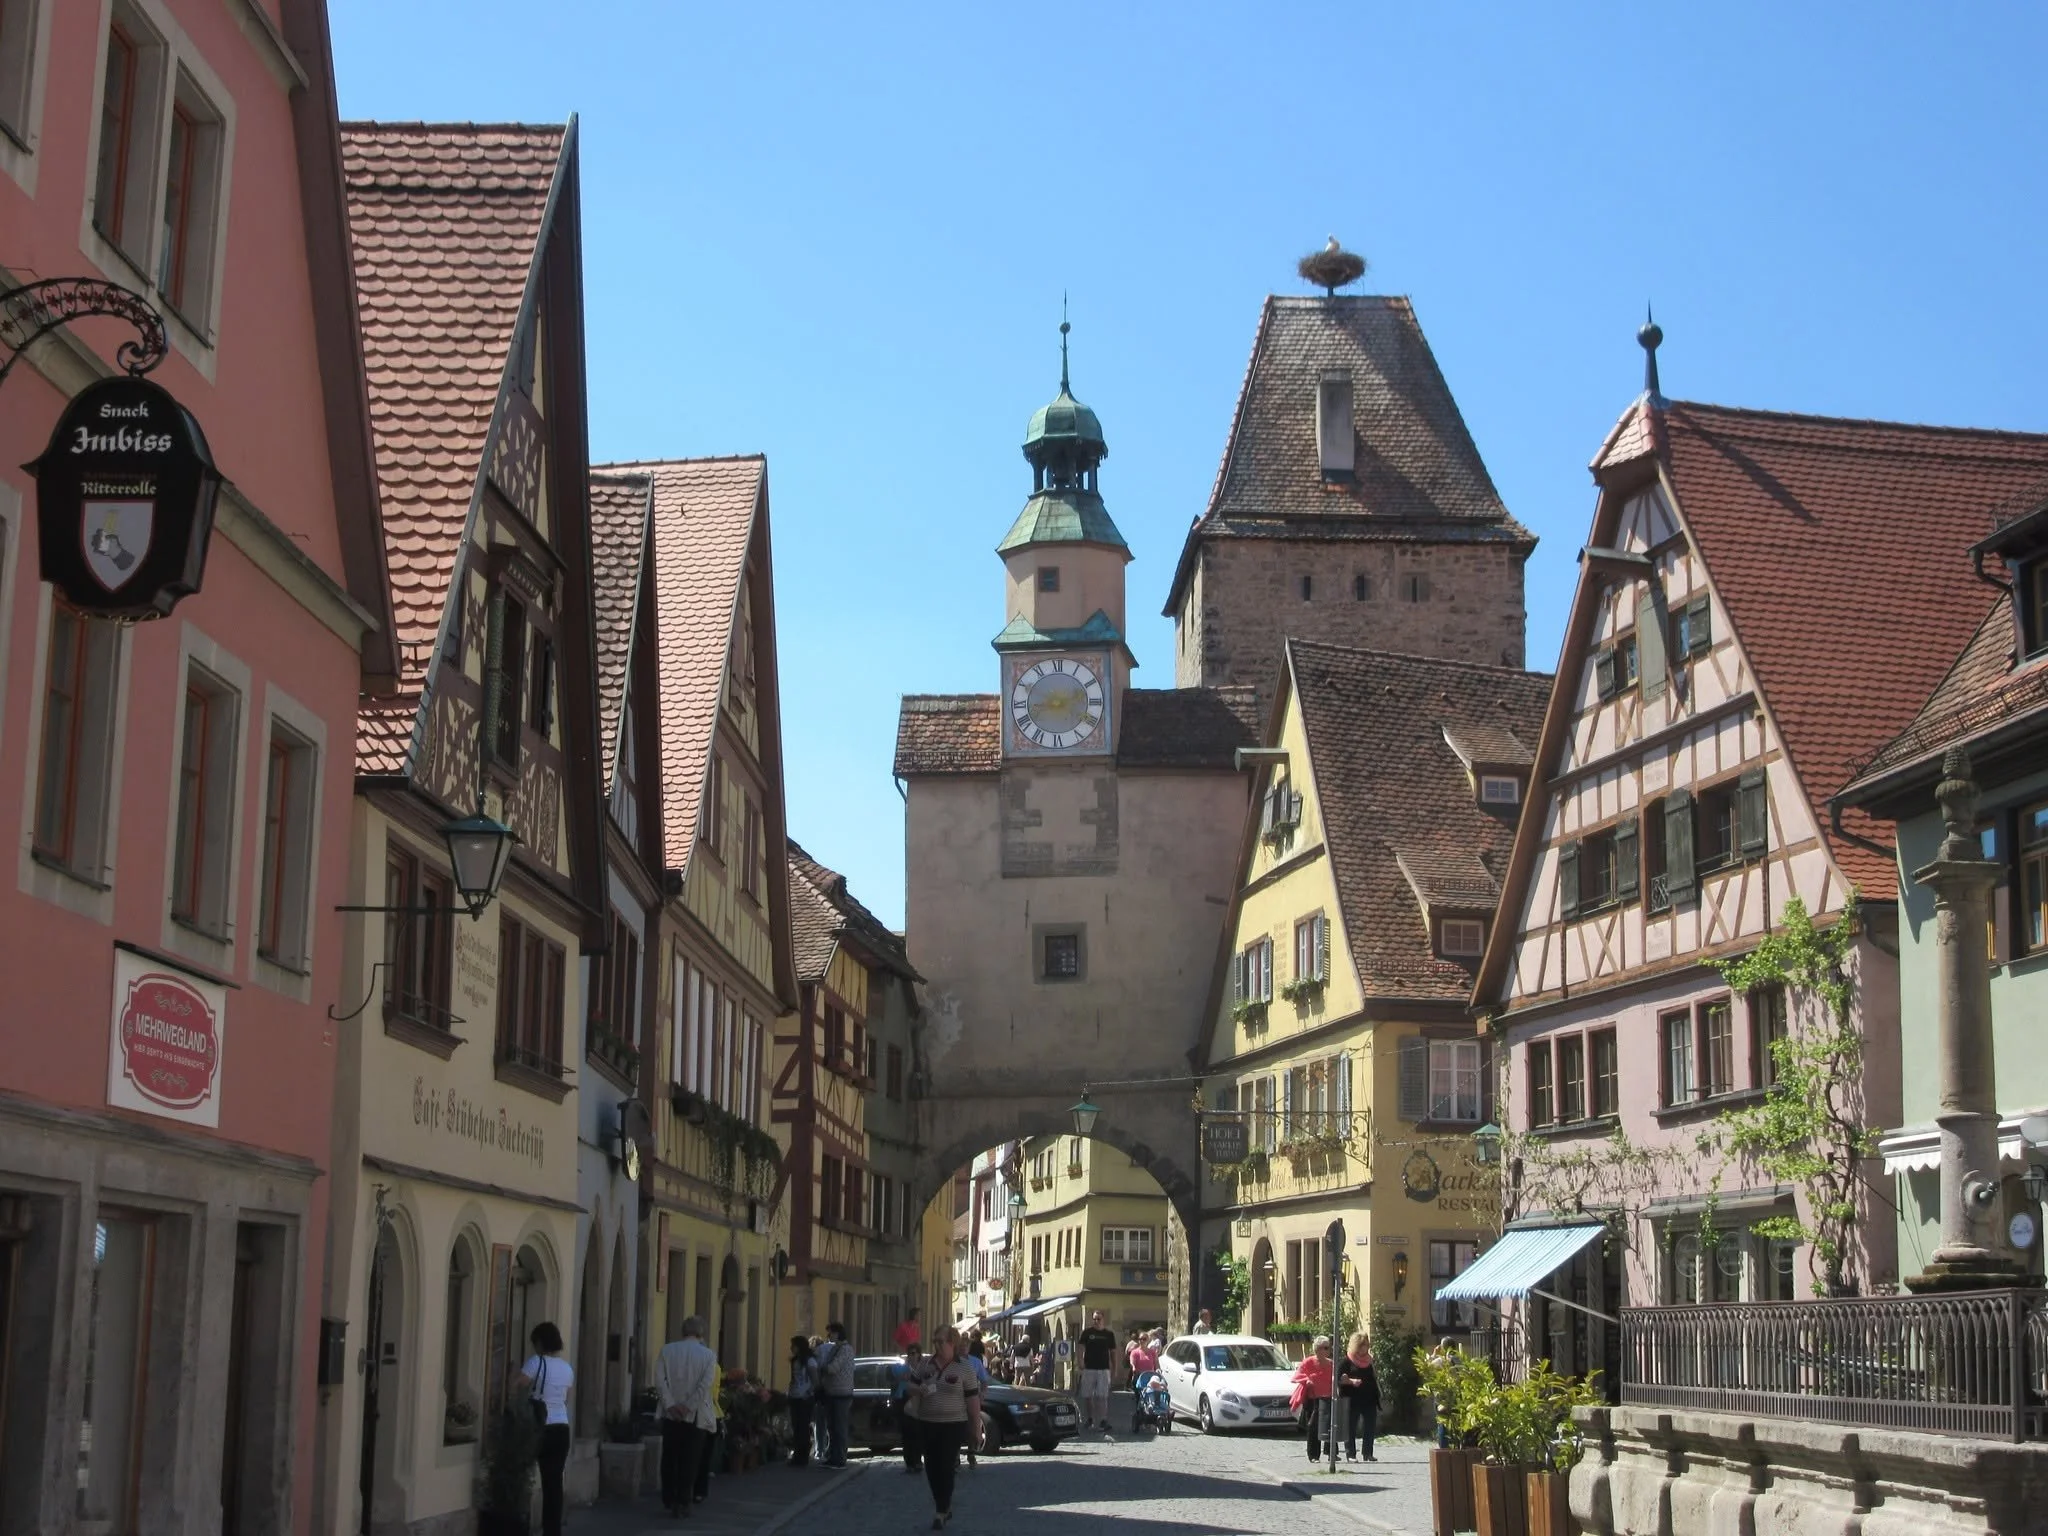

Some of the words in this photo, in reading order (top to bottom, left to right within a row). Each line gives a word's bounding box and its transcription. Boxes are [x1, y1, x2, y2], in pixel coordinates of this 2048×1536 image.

[100, 401, 149, 418] Snack
[70, 425, 172, 454] Imbiss
[80, 480, 157, 495] Ritterrolle
[135, 1013, 207, 1054] MEHRWEGLAND
